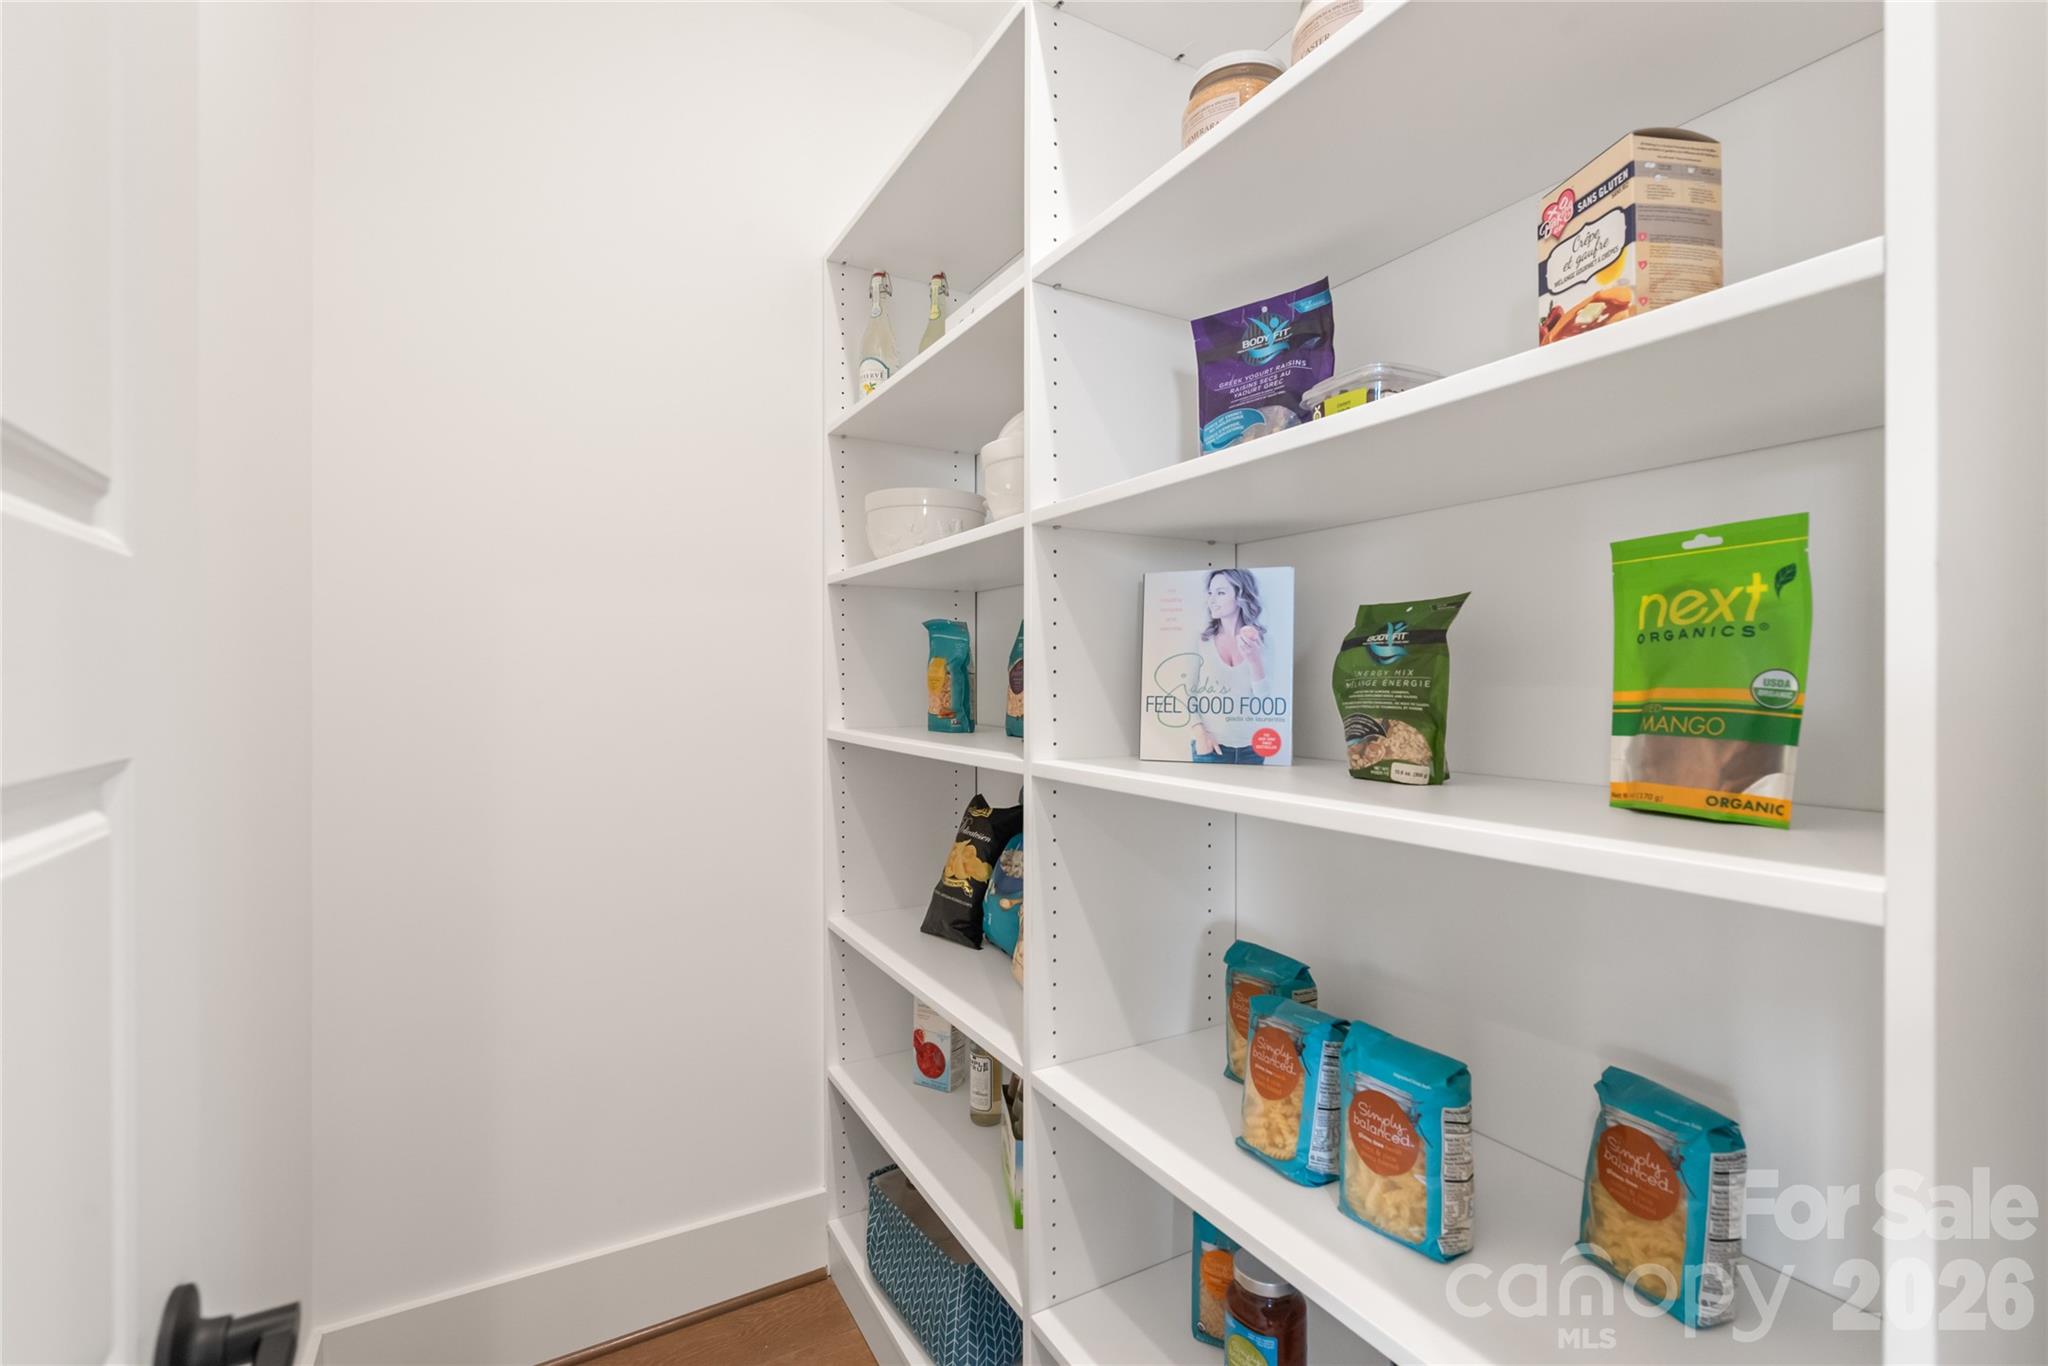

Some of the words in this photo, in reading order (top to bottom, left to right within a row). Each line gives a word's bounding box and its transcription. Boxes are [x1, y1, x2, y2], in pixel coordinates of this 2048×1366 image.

[1577, 191, 1598, 213] SANS
[1598, 168, 1629, 198] GLUTEN
[1242, 334, 1269, 349] BODY
[1273, 327, 1291, 339] FIT
[1219, 377, 1243, 389] GREEK
[1245, 368, 1273, 381] YOGURT
[1276, 360, 1307, 371] RAISINS
[1230, 382, 1257, 394] RAISINS
[1260, 374, 1278, 385] SECS
[1280, 370, 1292, 378] AU
[1263, 378, 1284, 390] GREC
[1639, 572, 1768, 630] next
[1366, 634, 1390, 643] BODY
[1392, 632, 1409, 641] FIT
[1763, 678, 1791, 688] USDA
[1145, 695, 1182, 714] FEEL
[1187, 695, 1234, 715] GOOD
[1240, 696, 1287, 716] FOOD
[1640, 715, 1726, 736] MANGO
[1706, 795, 1785, 817] ORGANIC
[1257, 1036, 1294, 1064] Simply
[1358, 1100, 1408, 1137] Simply
[1608, 1135, 1667, 1180] Simply
